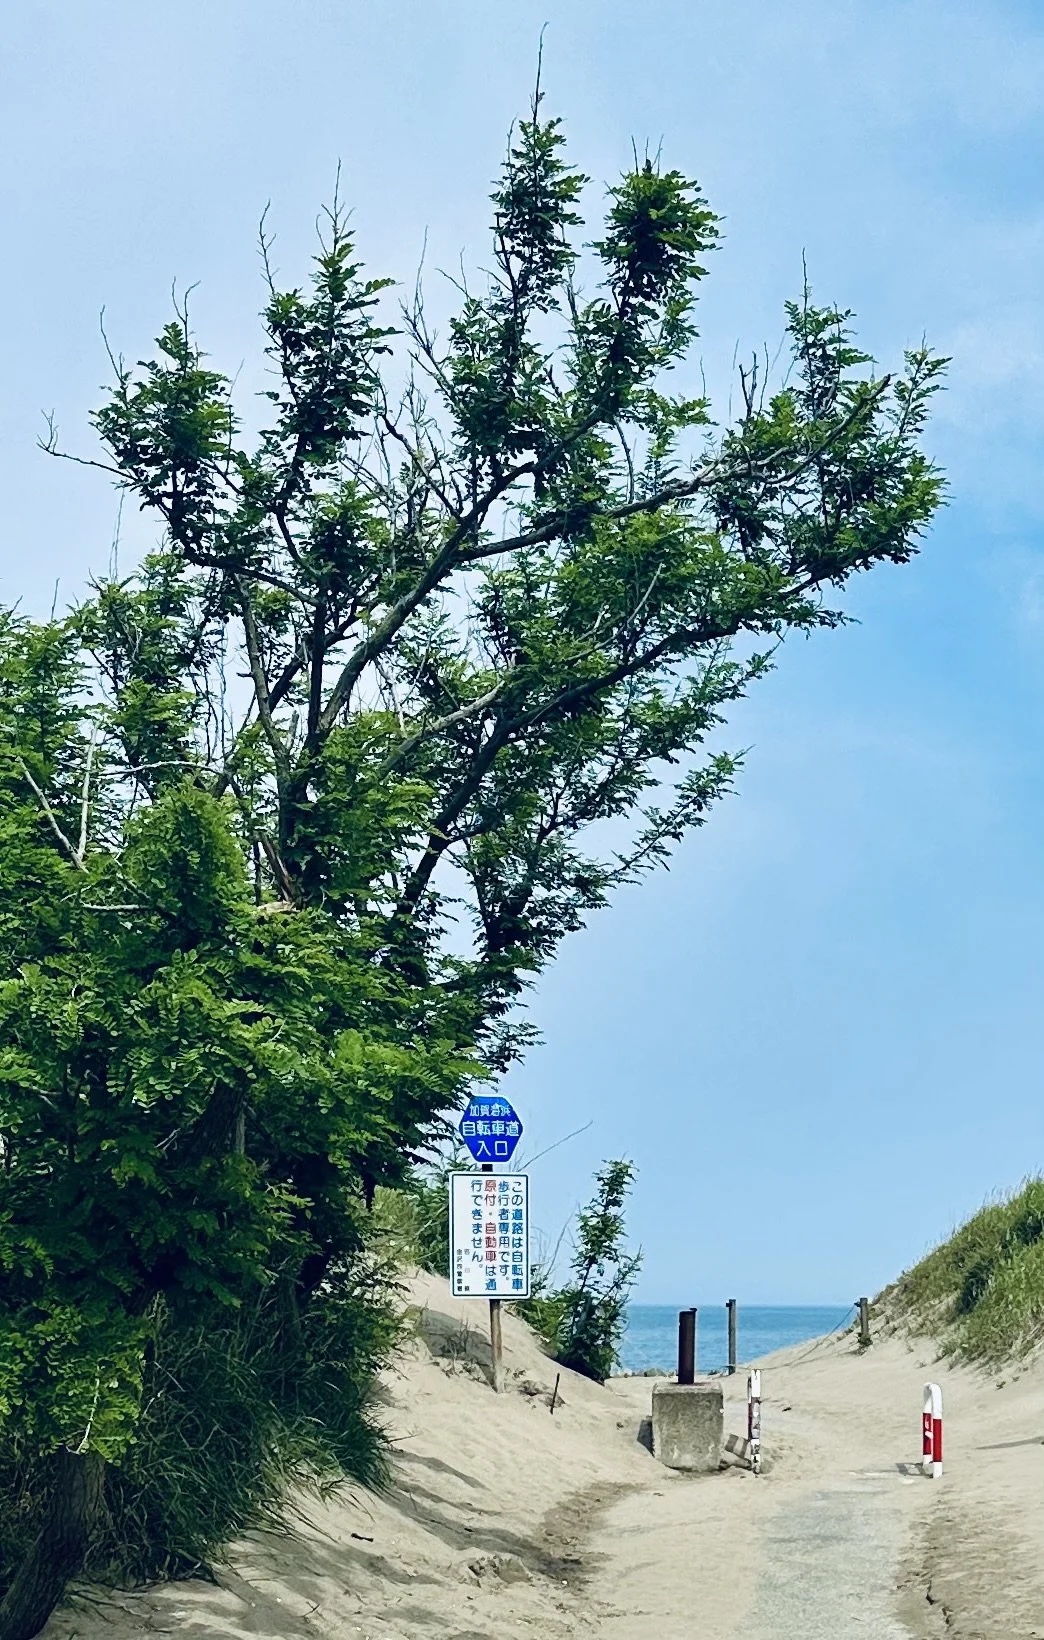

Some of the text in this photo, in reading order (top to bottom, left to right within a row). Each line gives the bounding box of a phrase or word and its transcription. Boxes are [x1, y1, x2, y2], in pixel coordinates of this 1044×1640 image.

[462, 1120, 520, 1137] 自転車道
[476, 1140, 508, 1156] 入口
[471, 1179, 483, 1269] 行できません。
[484, 1179, 497, 1291] 原付・自動車は通
[498, 1180, 510, 1281] 歩行者専用です。
[511, 1181, 524, 1291] この道路は自転車
